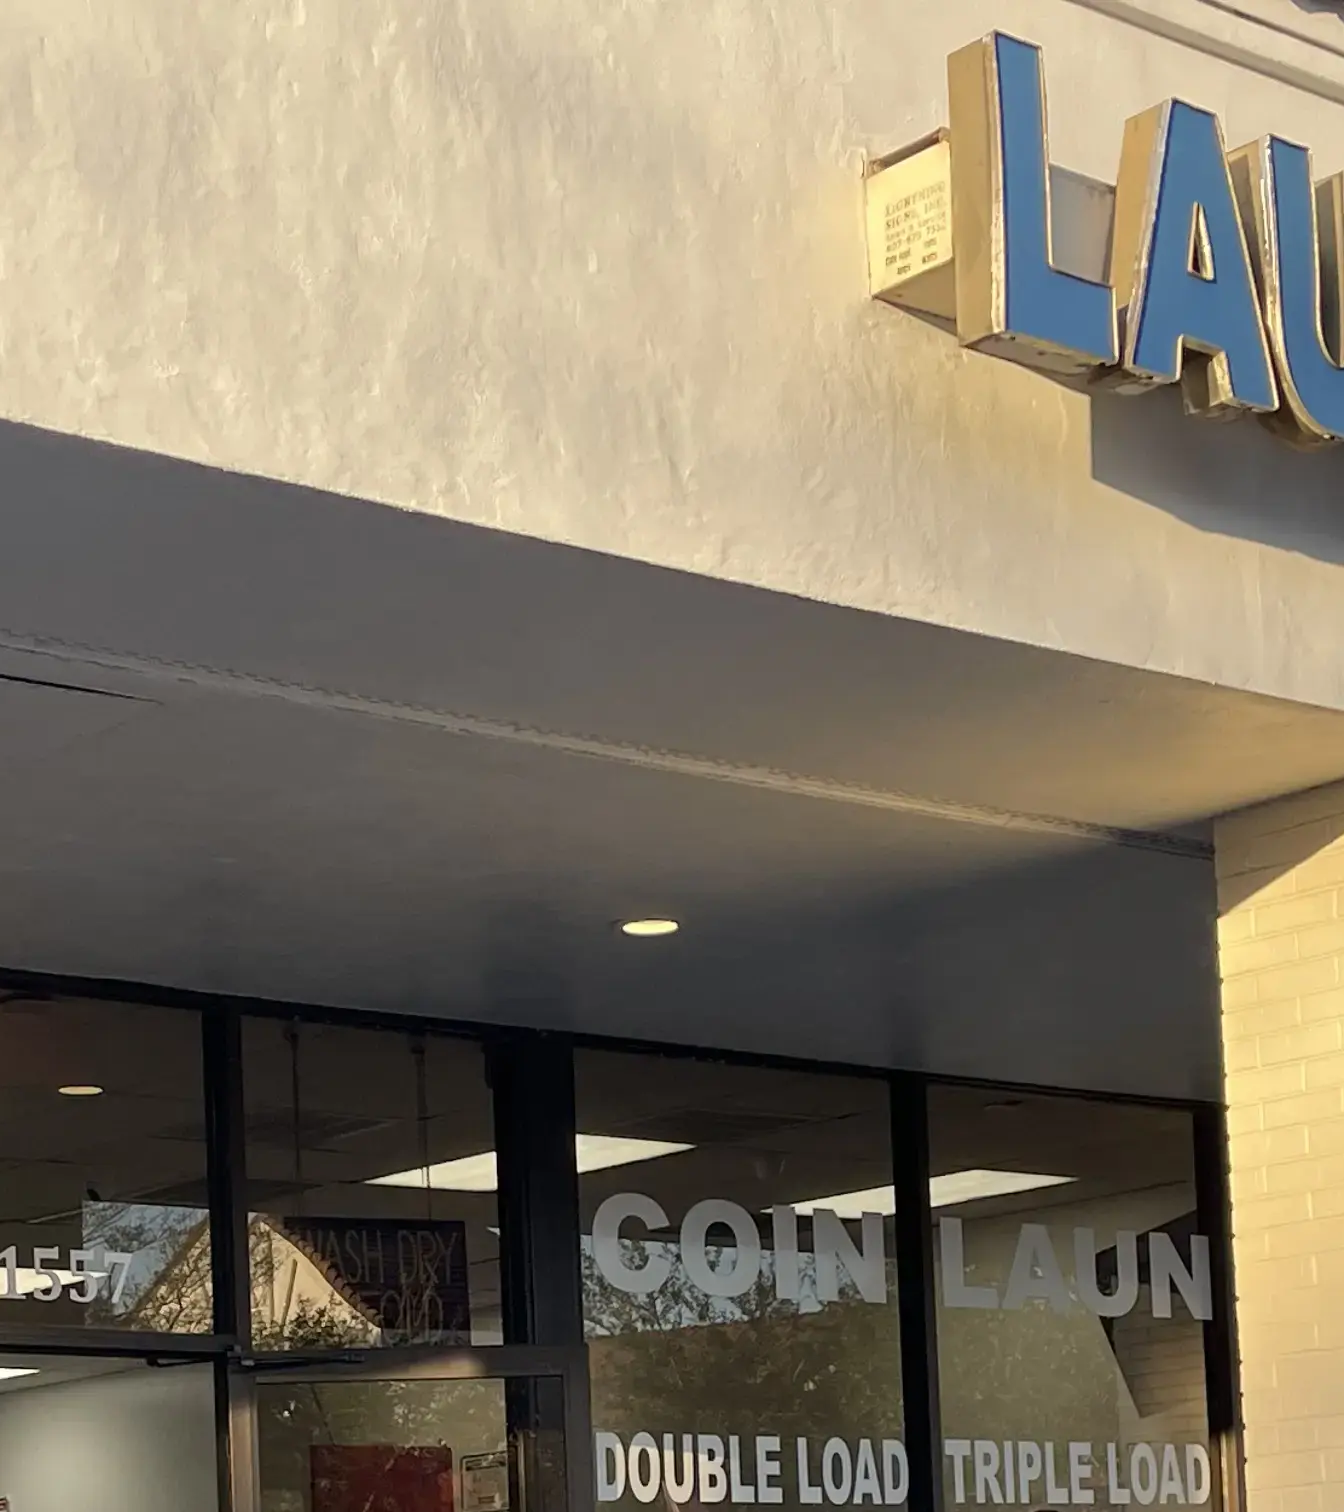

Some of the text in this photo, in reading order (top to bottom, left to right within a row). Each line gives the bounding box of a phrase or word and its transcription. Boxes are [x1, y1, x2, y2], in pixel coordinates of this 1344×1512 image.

[591, 1192, 1214, 1321] COIN LAUN
[594, 1431, 784, 1504] DOUBLE
[796, 1436, 910, 1506] LOAD
[944, 1438, 1211, 1506] TRIPLE LOAD
